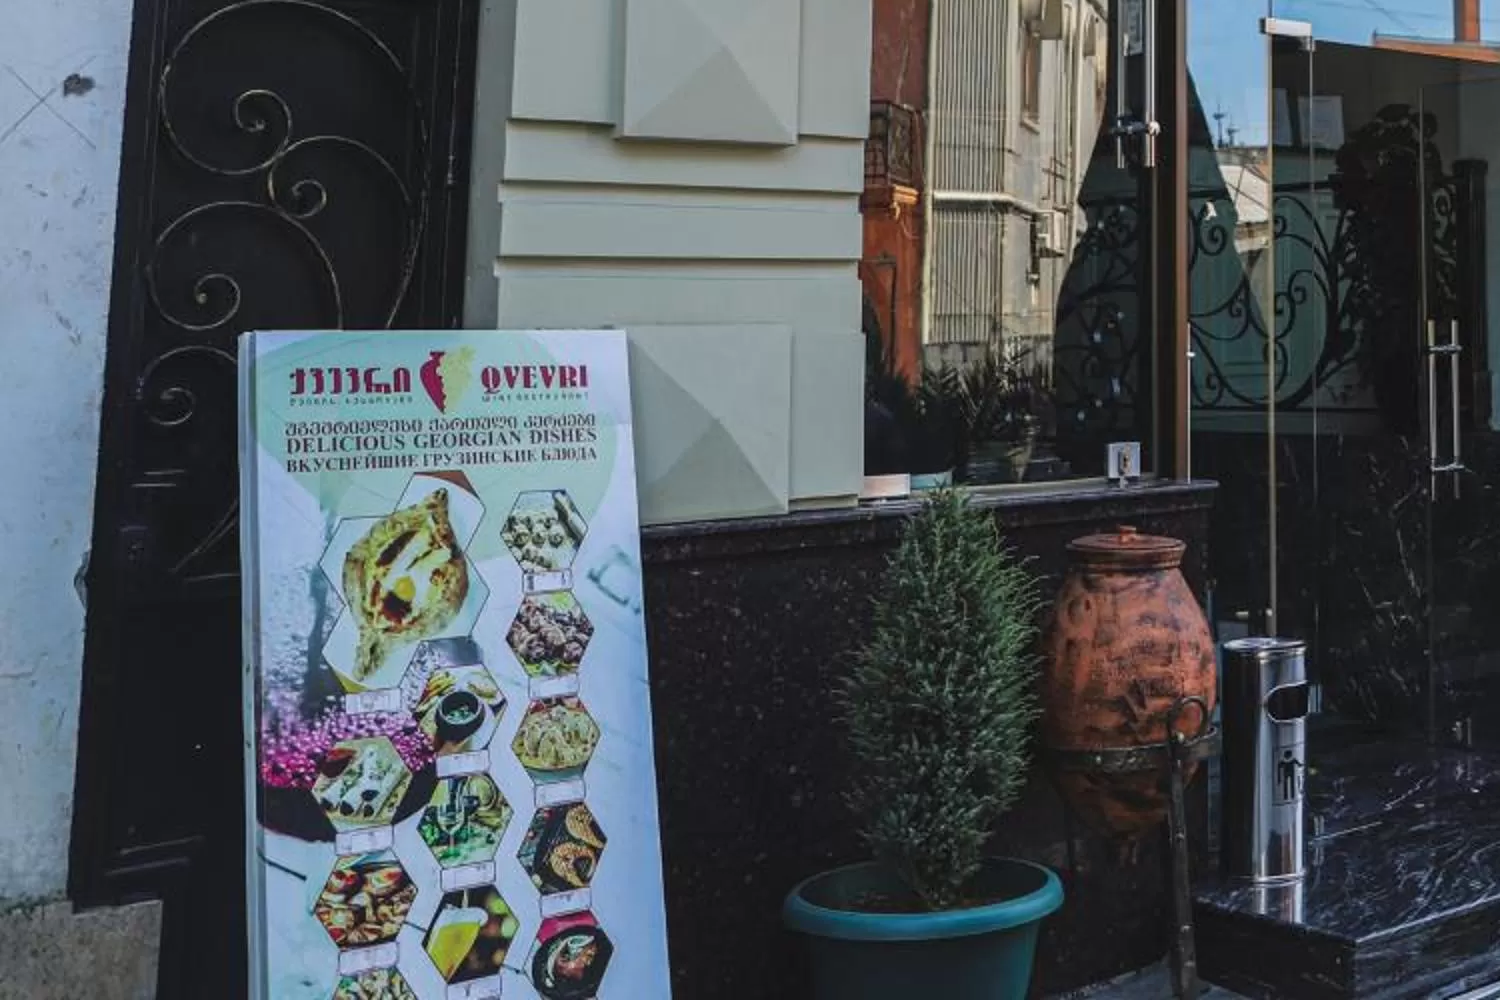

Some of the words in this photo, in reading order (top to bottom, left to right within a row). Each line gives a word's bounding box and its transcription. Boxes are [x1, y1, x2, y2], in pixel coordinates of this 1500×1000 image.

[481, 364, 588, 395] QVEVRI
[286, 434, 406, 455] DELICIOUS
[413, 431, 522, 450] GEORGIAN
[529, 427, 598, 446] DISHES
[286, 453, 419, 473] ВКУСНЕЙШИЕ
[422, 450, 538, 468] ГРУЗИНСКИЕ
[540, 448, 597, 463] БЛЮДА
